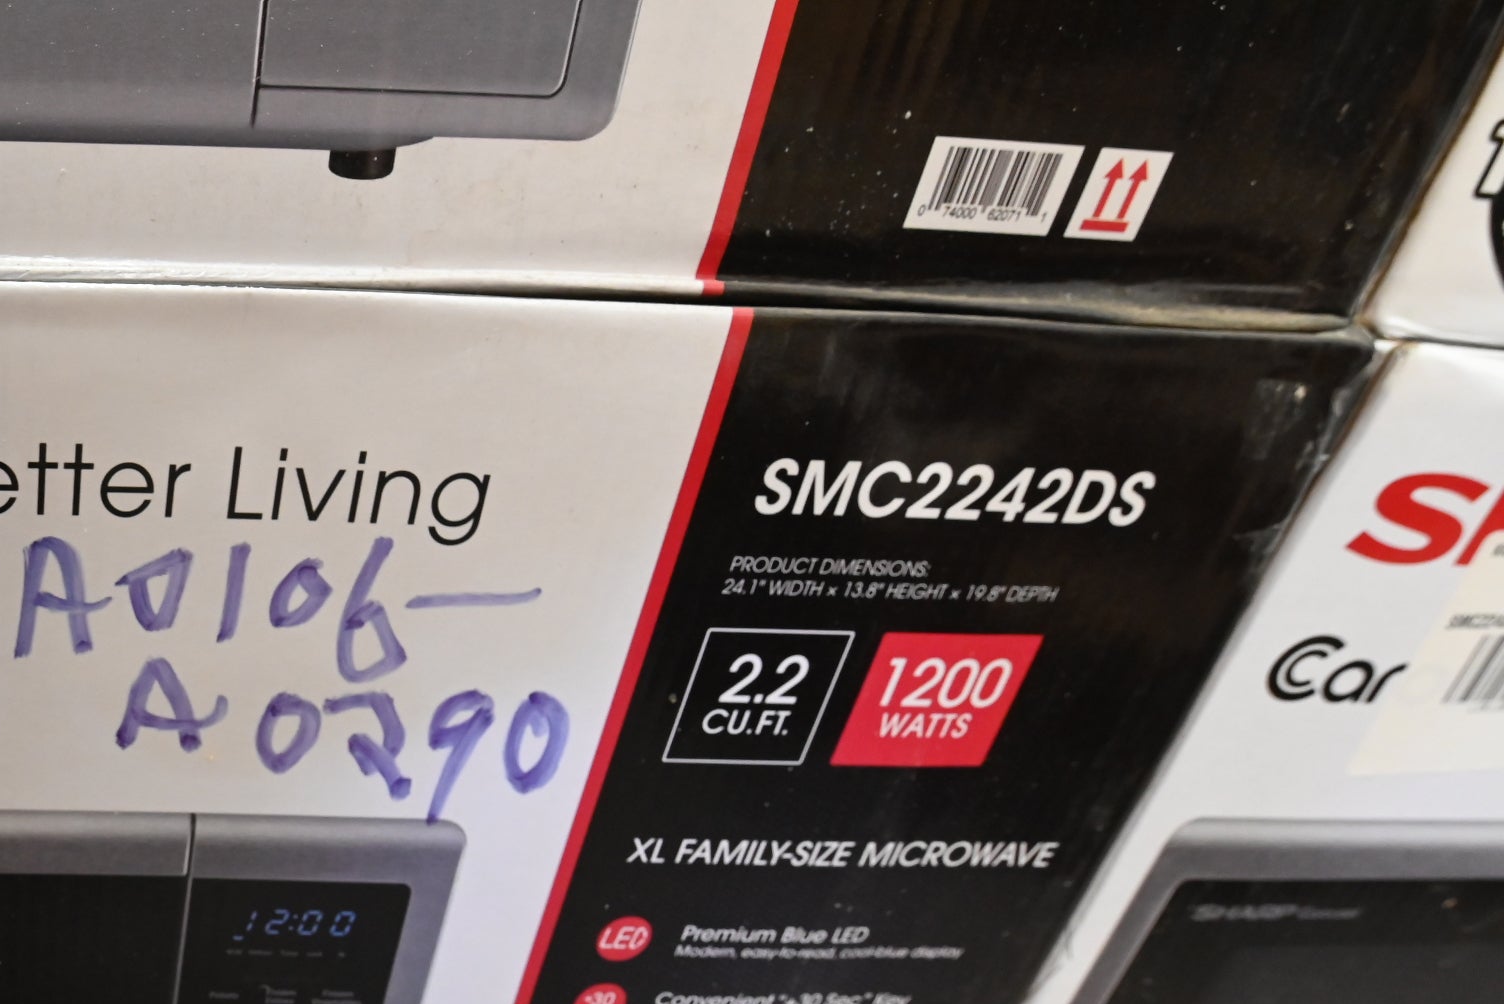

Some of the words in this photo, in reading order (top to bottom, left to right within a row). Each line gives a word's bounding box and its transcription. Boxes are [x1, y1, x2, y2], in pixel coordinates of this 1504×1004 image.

[228, 445, 491, 546] Living
[754, 458, 1157, 527] SMC2242DS
[730, 555, 817, 574] PRODUCT
[768, 579, 826, 597] WIDTH
[885, 582, 950, 600] HEIGHT
[1005, 585, 1061, 603] DEPTH
[718, 652, 810, 706] 2.2
[878, 656, 1014, 709] 1200
[701, 709, 792, 737] CU.FT.
[878, 712, 973, 740] WATTS
[626, 838, 665, 865] XL
[674, 838, 856, 868] FAMILY-SIZE
[858, 840, 1061, 868] MICROWAVE
[246, 909, 356, 938] 12:00
[680, 925, 777, 944] Premium
[779, 926, 829, 944] Blue
[831, 926, 871, 944] LED
[598, 926, 649, 951] LED
